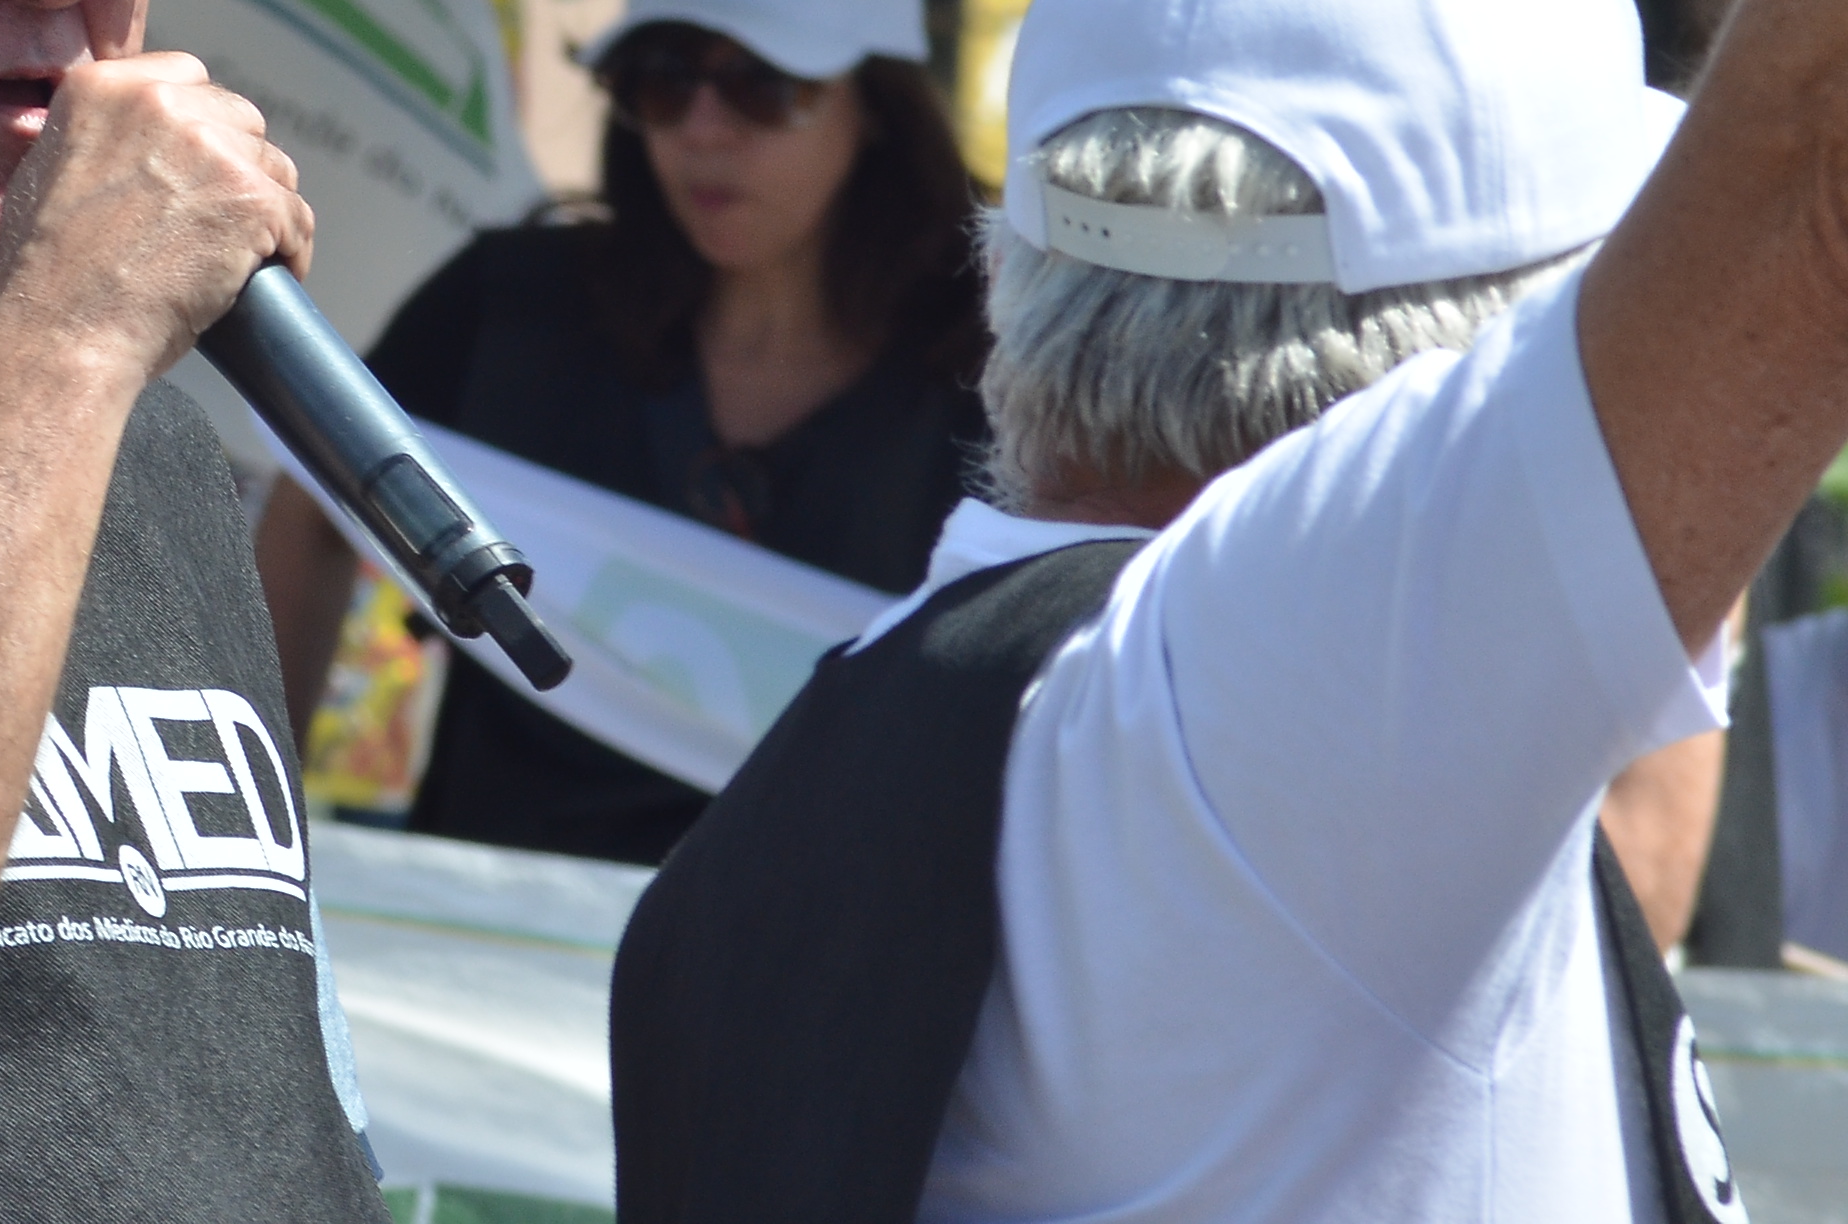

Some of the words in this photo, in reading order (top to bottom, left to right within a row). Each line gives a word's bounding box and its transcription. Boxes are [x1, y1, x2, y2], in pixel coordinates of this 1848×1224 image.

[57, 914, 93, 942] dos
[178, 925, 214, 949] Rio
[212, 923, 280, 949] Grande
